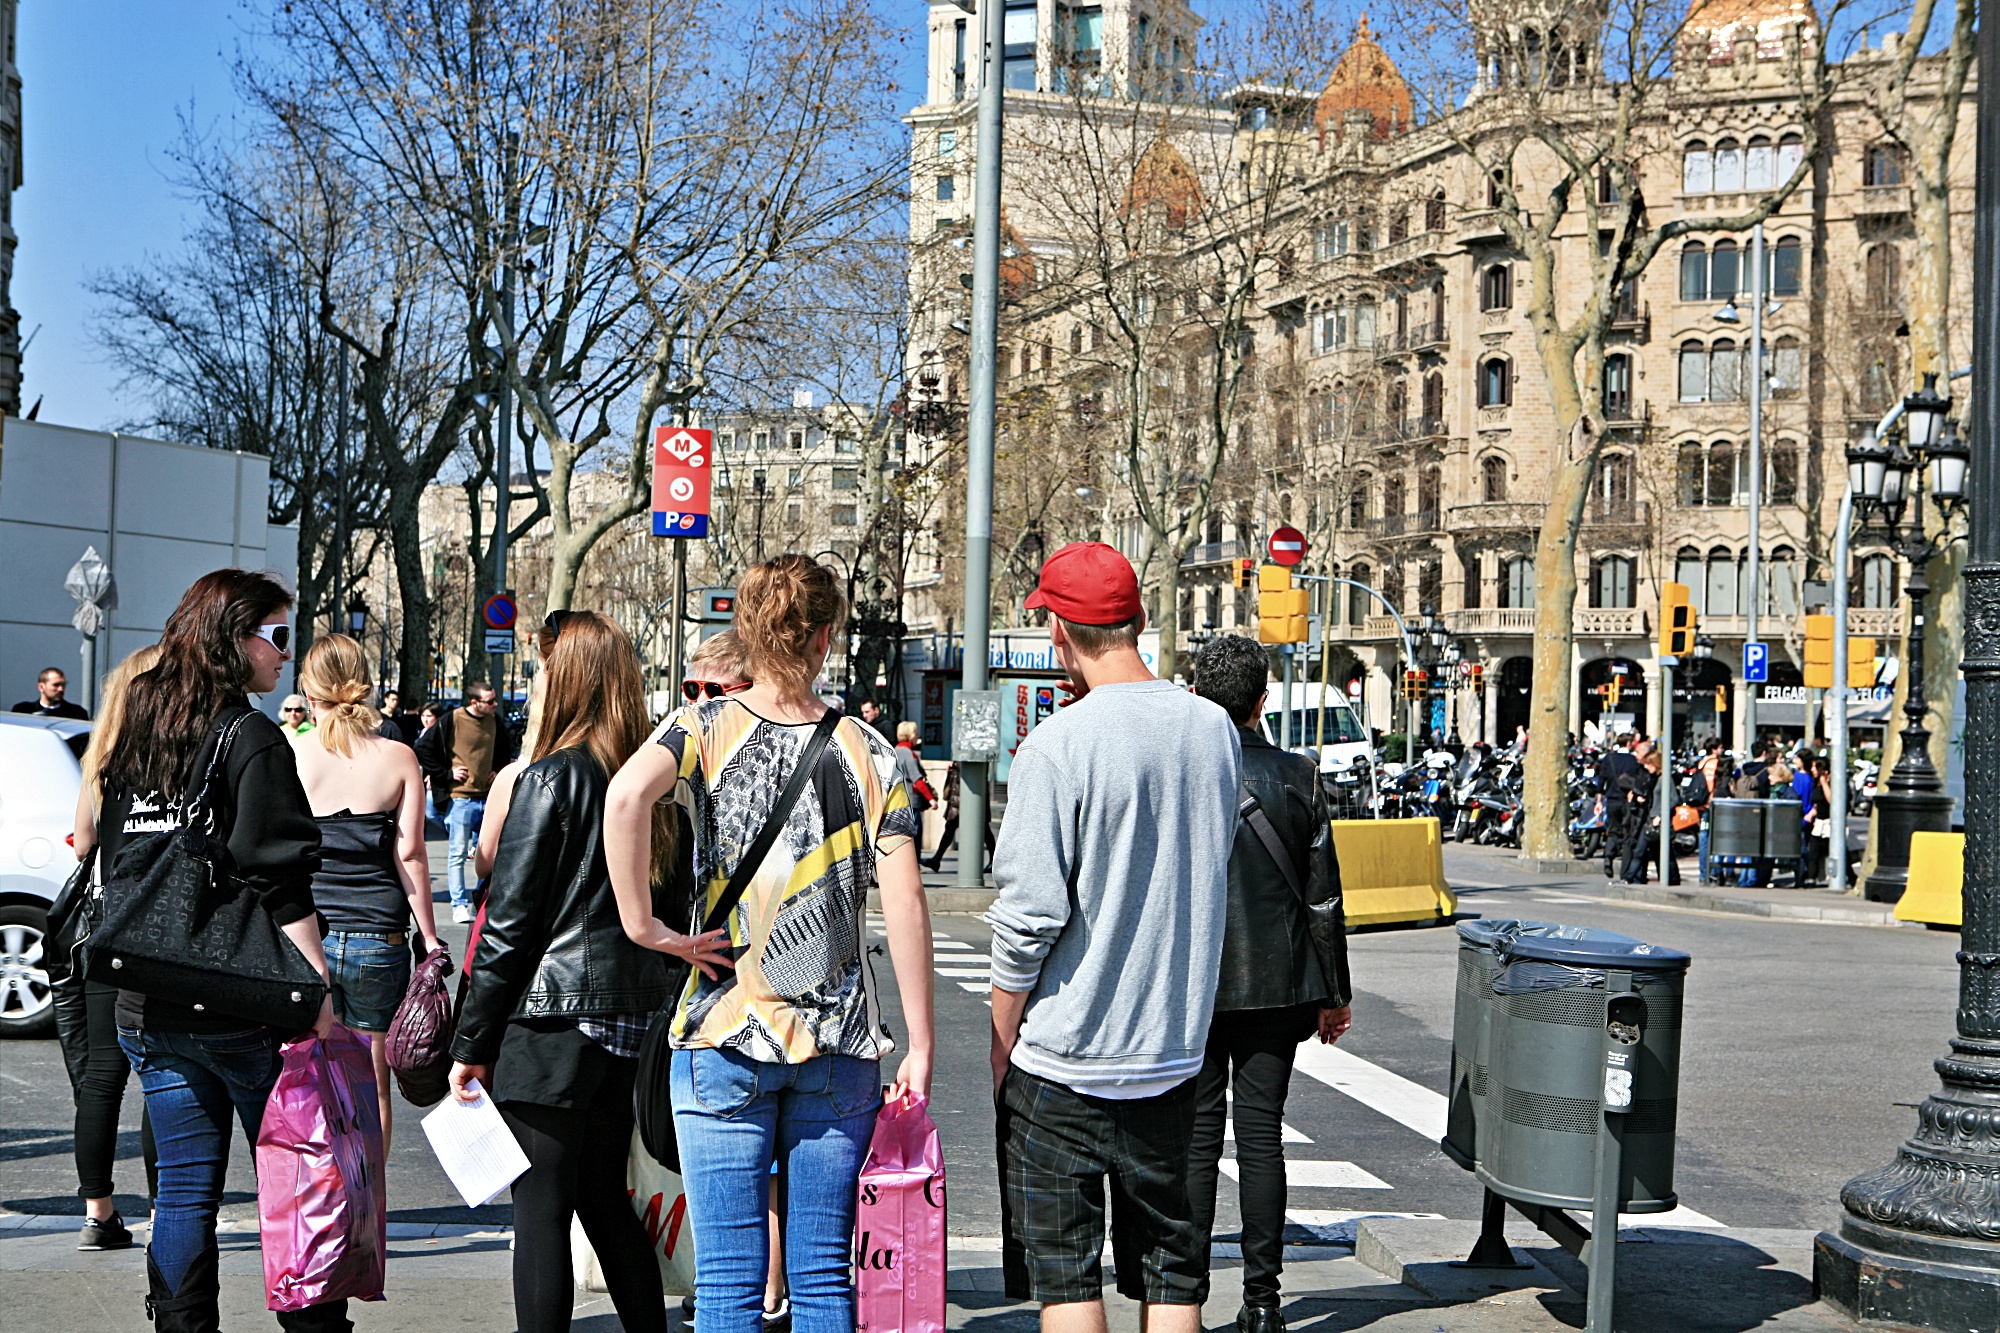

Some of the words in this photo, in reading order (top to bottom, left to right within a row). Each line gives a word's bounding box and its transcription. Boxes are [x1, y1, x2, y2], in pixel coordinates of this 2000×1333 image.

[674, 438, 691, 453] M
[665, 511, 680, 529] P
[989, 645, 1053, 670] iagonal
[1747, 645, 1764, 667] P
[1764, 686, 1806, 700] FELGAR
[1016, 684, 1028, 738] CEPSA
